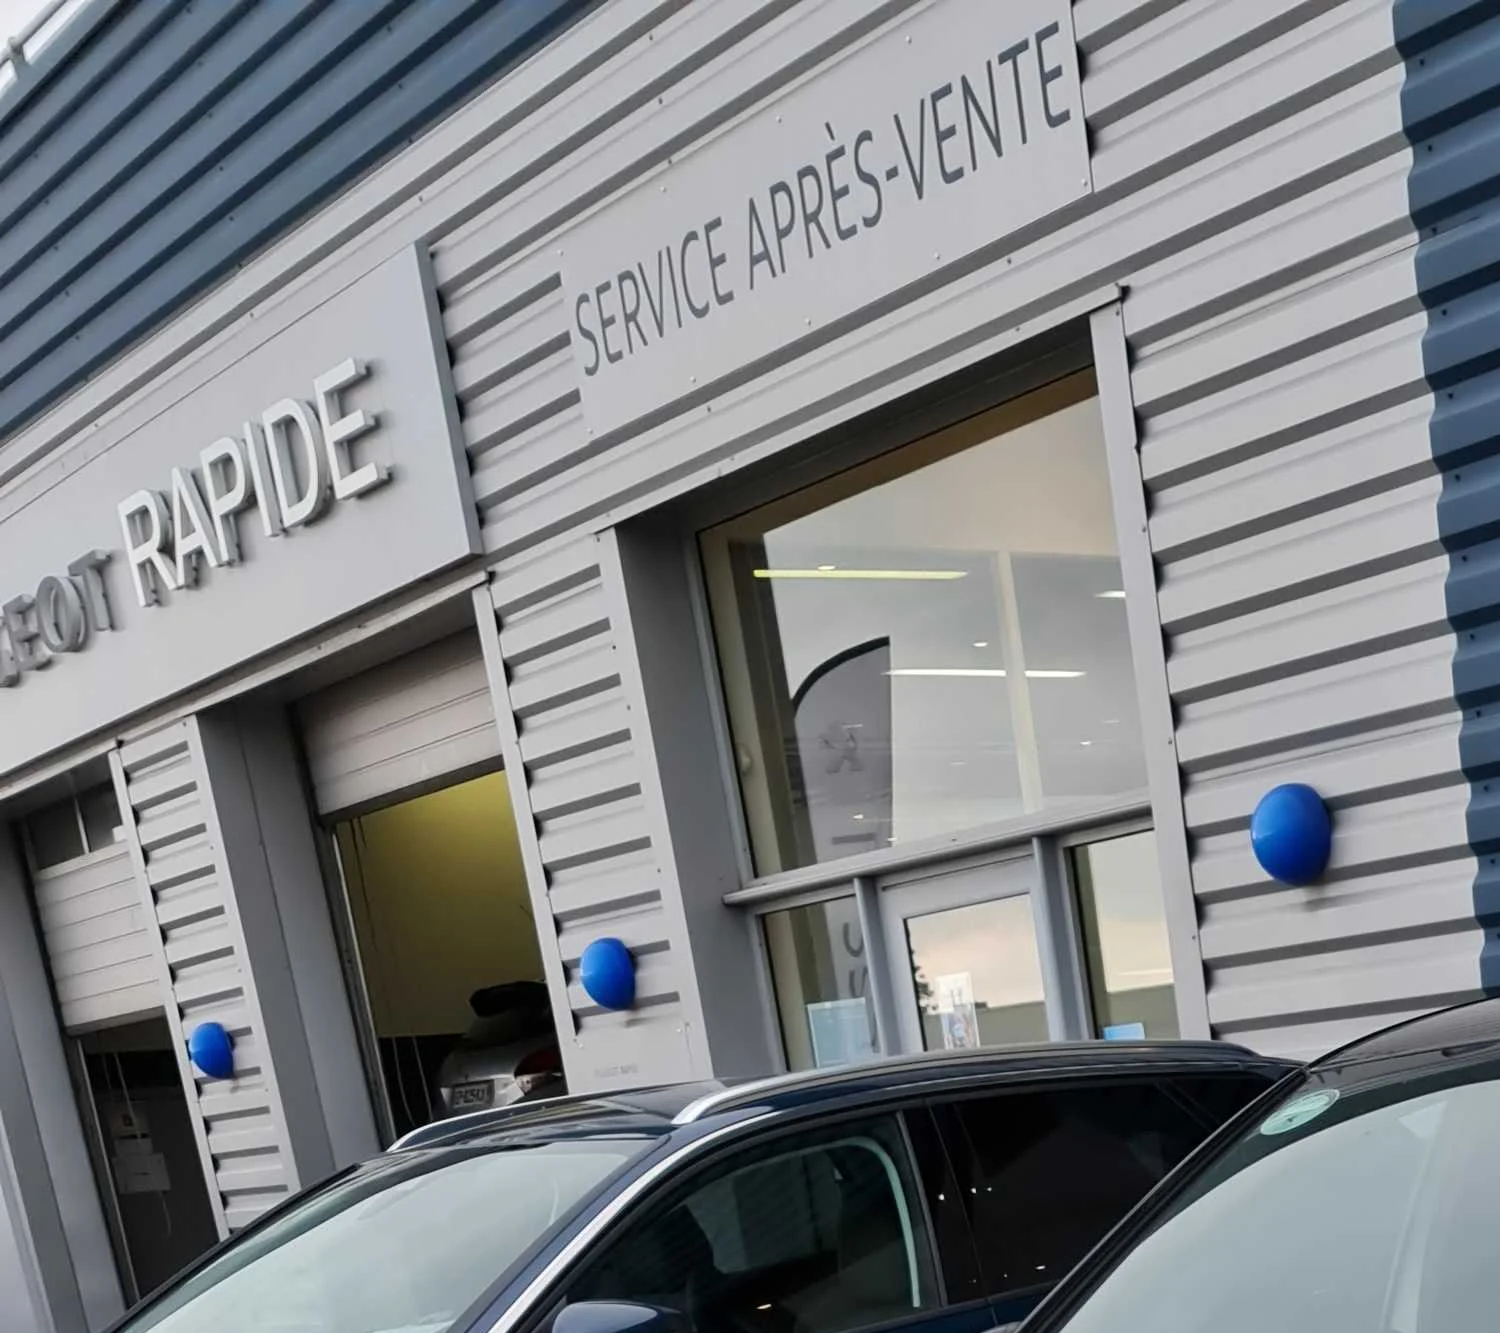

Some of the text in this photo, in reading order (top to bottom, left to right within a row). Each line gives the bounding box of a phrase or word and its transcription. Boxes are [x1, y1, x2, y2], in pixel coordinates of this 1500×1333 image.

[575, 20, 1071, 377] SERVICE APRÈS-VENTE
[117, 356, 392, 608] RAPIDE
